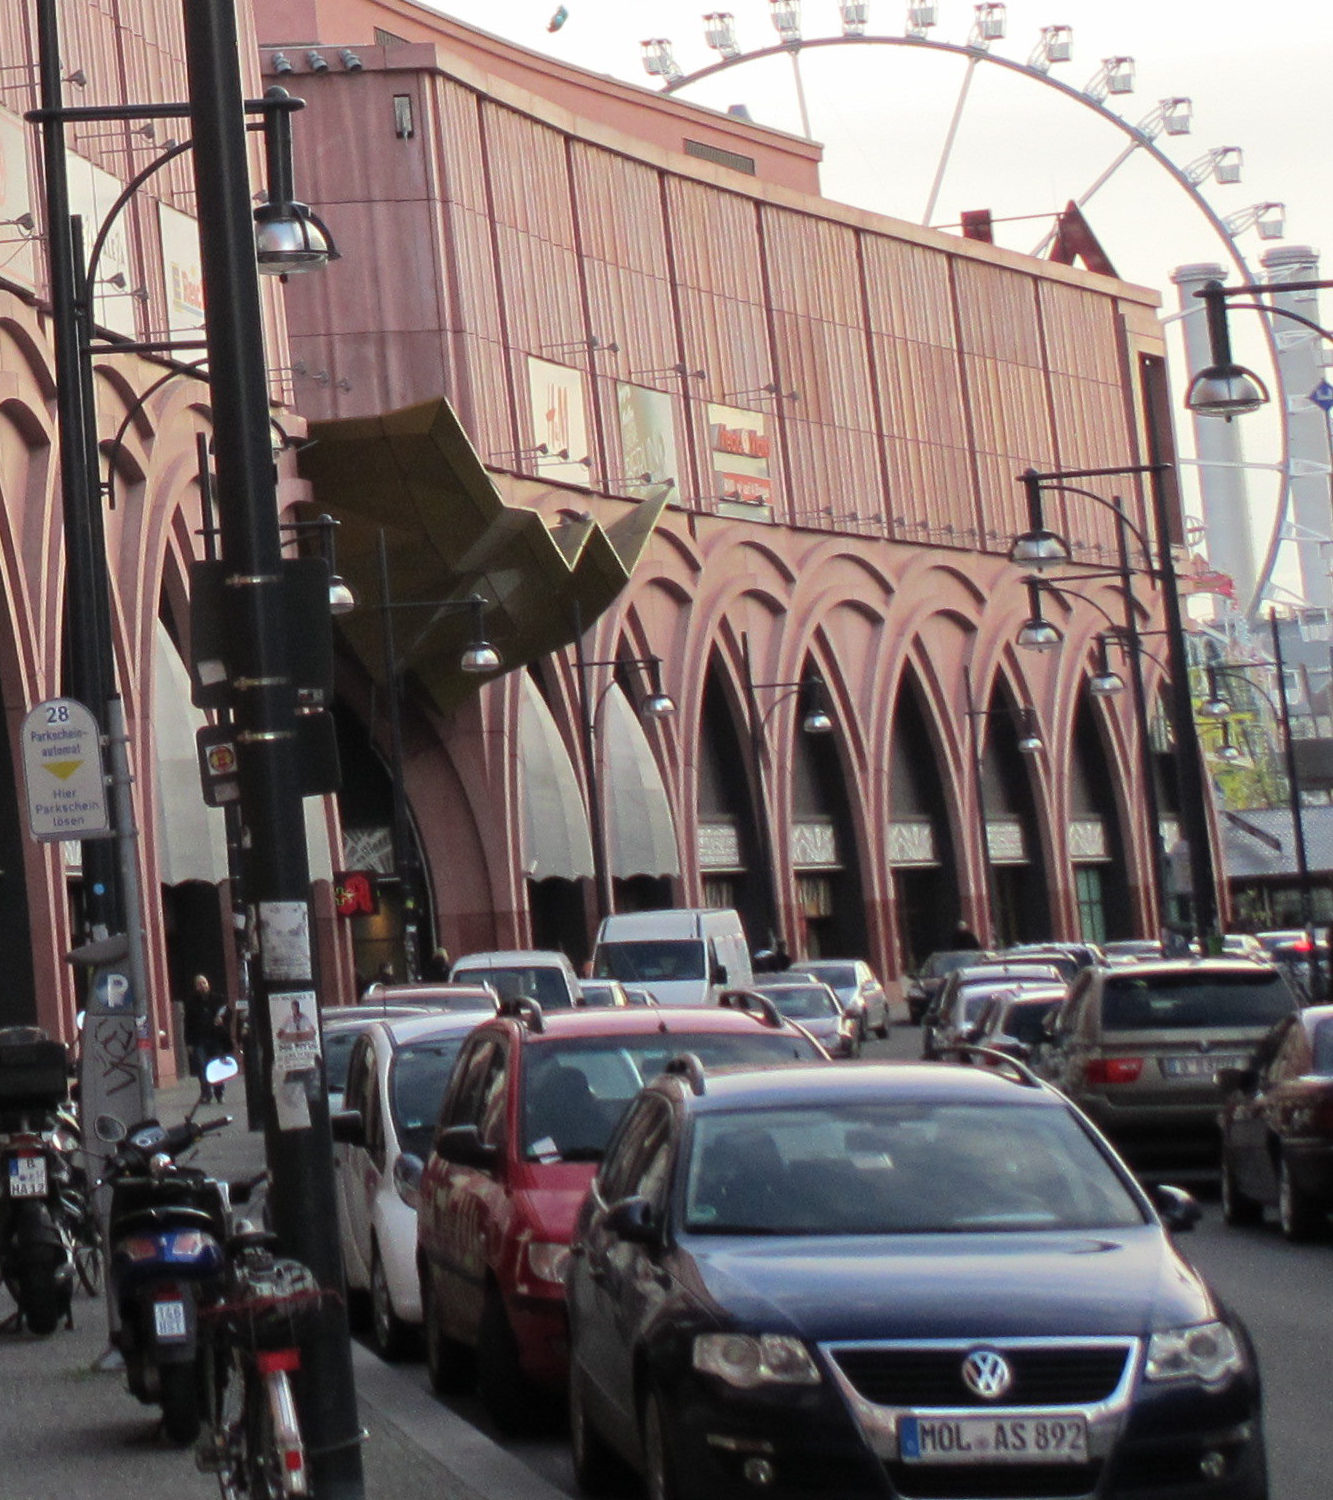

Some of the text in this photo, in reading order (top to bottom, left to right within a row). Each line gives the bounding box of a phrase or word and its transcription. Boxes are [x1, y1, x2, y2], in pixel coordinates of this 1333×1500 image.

[46, 705, 70, 723] 28
[41, 744, 81, 758] automat
[52, 788, 77, 800] Hier
[35, 801, 101, 815] Parkschein
[920, 1420, 1083, 1451] MOL AS 892
